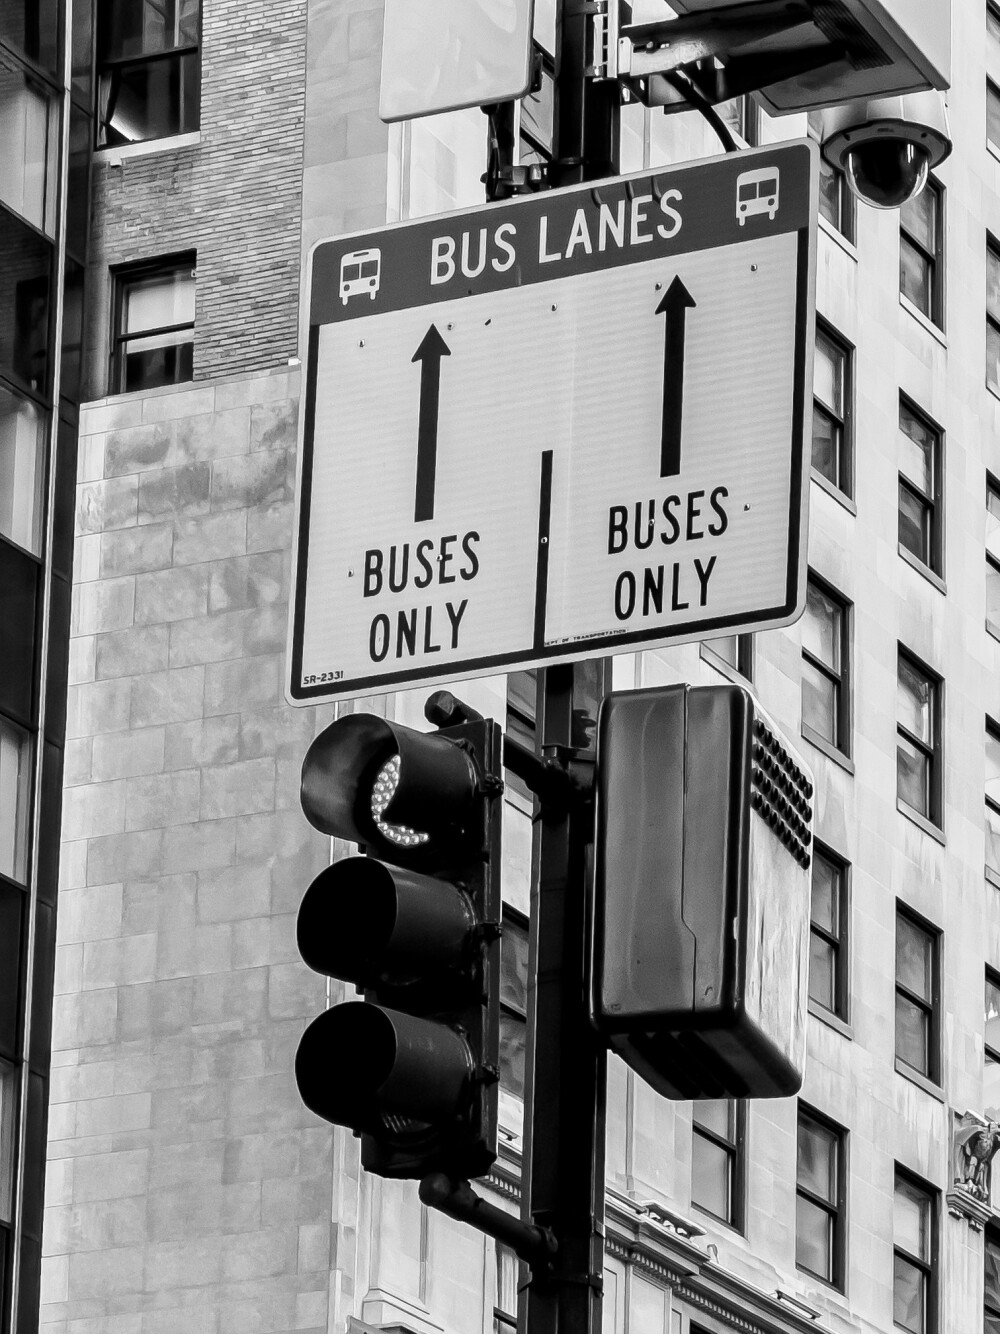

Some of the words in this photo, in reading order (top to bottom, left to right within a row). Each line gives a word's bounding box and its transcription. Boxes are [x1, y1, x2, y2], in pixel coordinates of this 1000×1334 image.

[430, 222, 517, 285] BUS
[538, 188, 683, 264] LANES
[607, 486, 729, 554] BUSES
[363, 530, 481, 598] BUSES
[613, 556, 717, 621] ONLY
[368, 600, 469, 662] ONLY
[303, 670, 344, 685] SR-2331
